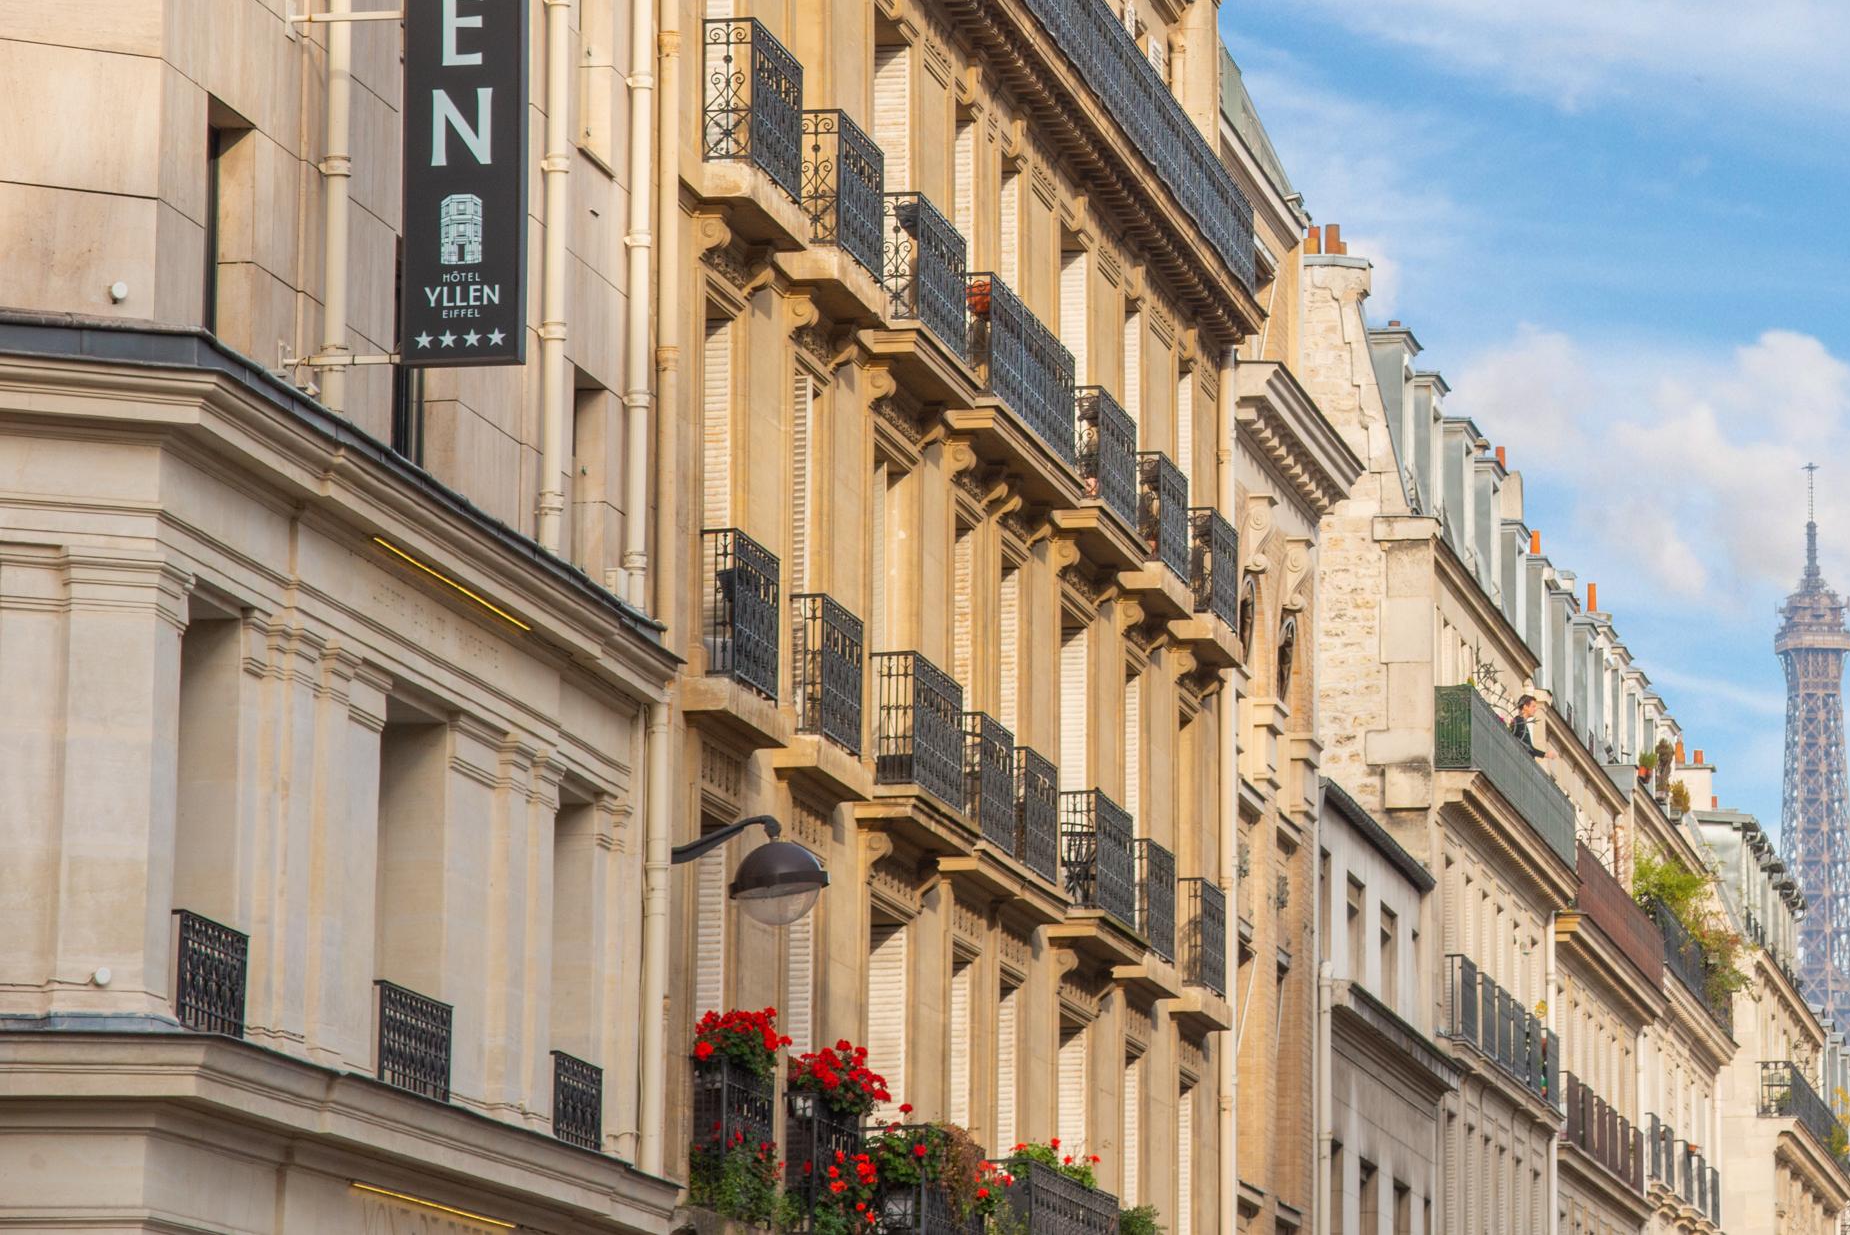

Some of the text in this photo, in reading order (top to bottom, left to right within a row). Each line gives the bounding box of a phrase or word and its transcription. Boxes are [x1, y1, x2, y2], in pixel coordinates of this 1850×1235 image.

[442, 270, 481, 282] HÔTEL
[424, 284, 500, 307] YLLEN
[442, 308, 481, 319] EIFFEL
